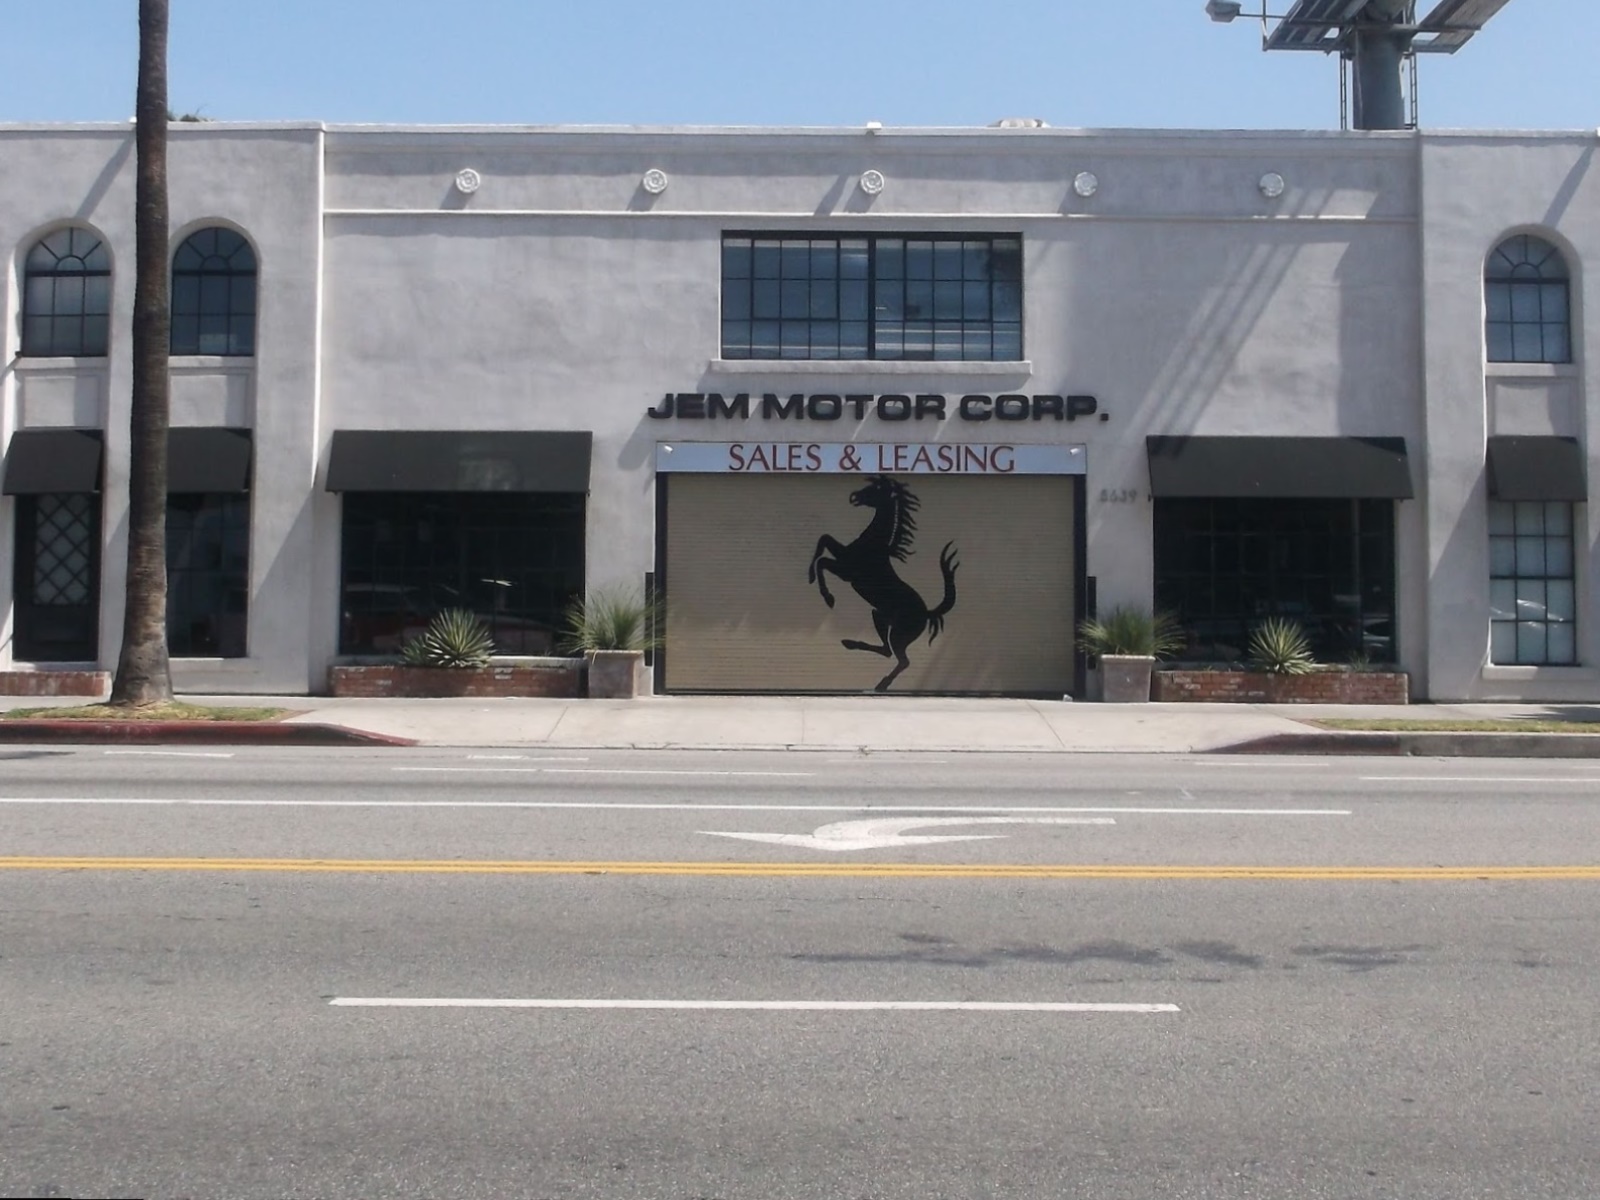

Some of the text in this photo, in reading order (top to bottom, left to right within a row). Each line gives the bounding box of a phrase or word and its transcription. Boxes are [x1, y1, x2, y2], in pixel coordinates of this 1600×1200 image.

[648, 393, 1109, 421] JEM MOTOR CORP.
[728, 444, 1016, 472] SALES & LEASING
